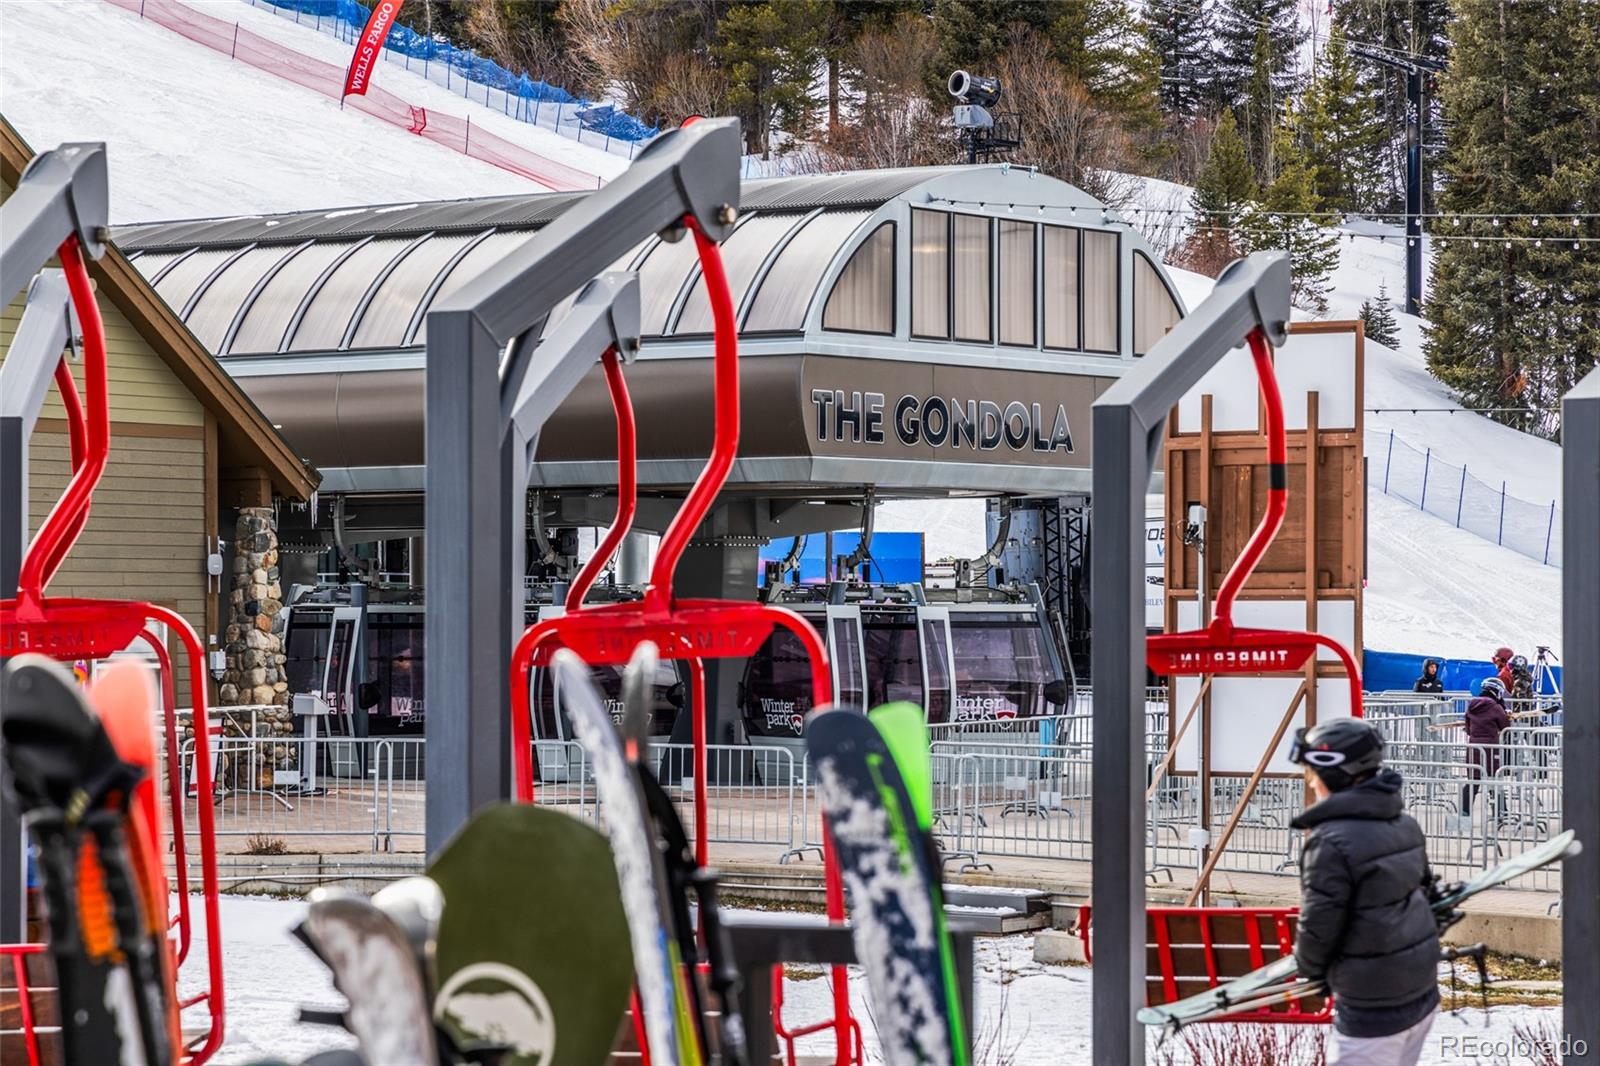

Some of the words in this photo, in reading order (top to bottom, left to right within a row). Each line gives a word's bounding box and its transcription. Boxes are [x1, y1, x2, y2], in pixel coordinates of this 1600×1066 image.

[351, 46, 374, 90] WELLS
[366, 2, 393, 46] FARGO
[812, 388, 885, 444] THE
[894, 394, 1075, 454] GONDOLA
[760, 698, 795, 713] Winter
[955, 695, 1004, 709] inter
[765, 711, 794, 730] park
[958, 706, 993, 721] ark
